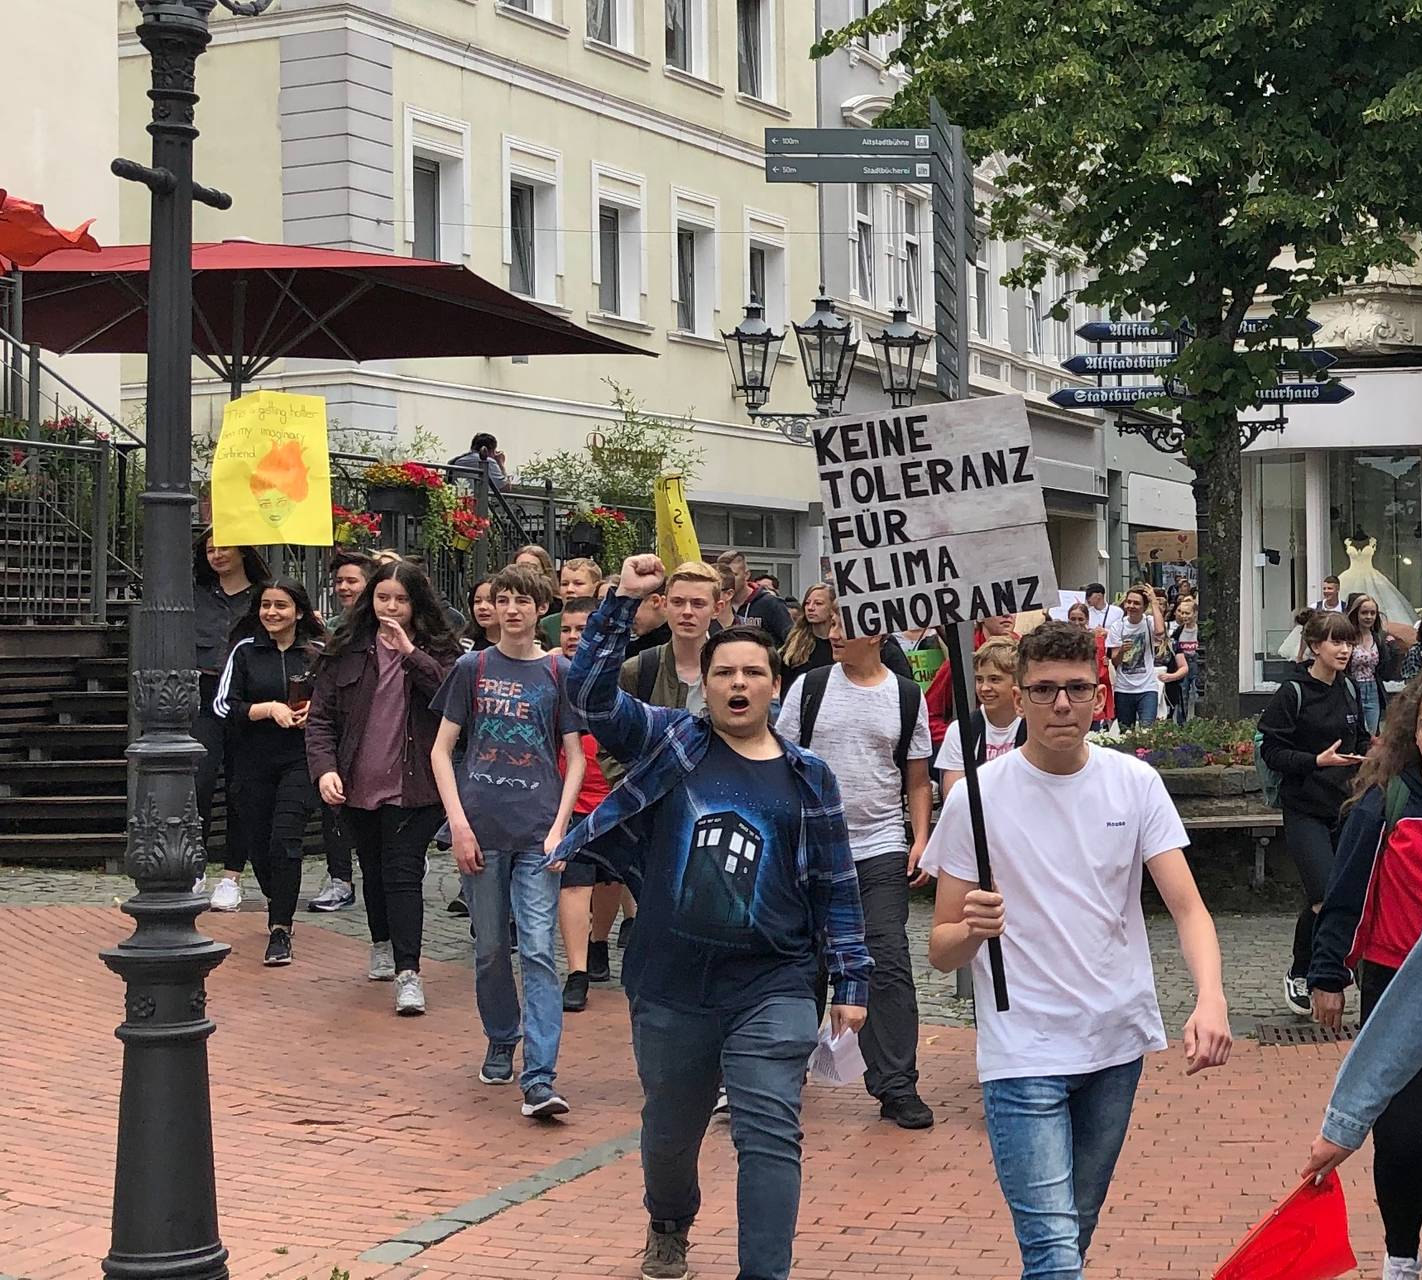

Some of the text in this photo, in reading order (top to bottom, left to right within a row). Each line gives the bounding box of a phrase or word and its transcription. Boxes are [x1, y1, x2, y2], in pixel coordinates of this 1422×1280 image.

[781, 137, 911, 147] 100m Altstadtbühne
[782, 165, 911, 175] 50m Stadtbücherei
[813, 415, 932, 466] KEINE
[820, 445, 1034, 509] TOLERANZ
[828, 508, 911, 554] FÜR
[834, 546, 960, 597] KLIMA
[841, 575, 1043, 640] IGNORANZ
